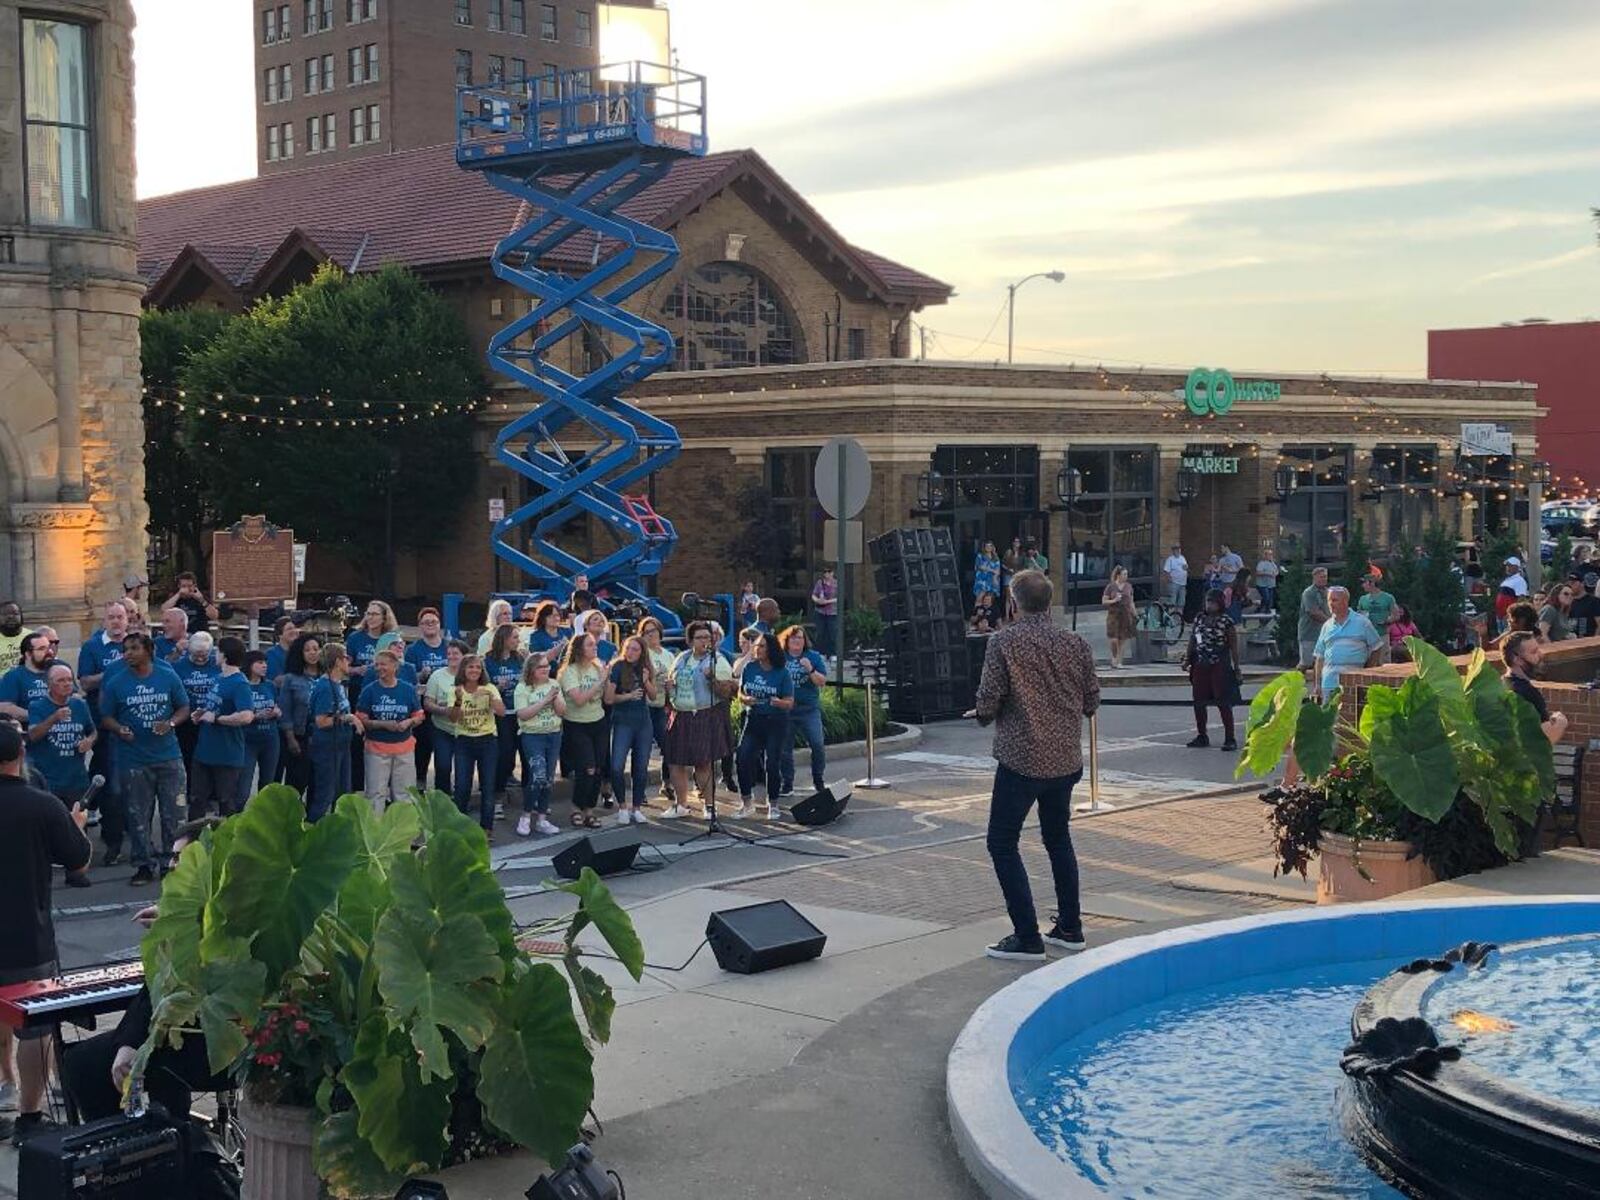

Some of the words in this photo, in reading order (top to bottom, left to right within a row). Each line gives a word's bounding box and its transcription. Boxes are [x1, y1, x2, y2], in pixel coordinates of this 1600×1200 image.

[1183, 457, 1240, 474] MARKET
[136, 685, 155, 695] The
[126, 693, 168, 706] CHAMPION
[379, 695, 397, 705] The
[139, 703, 158, 713] CITY
[371, 704, 408, 713] CHAMPION
[57, 733, 75, 742] CITY
